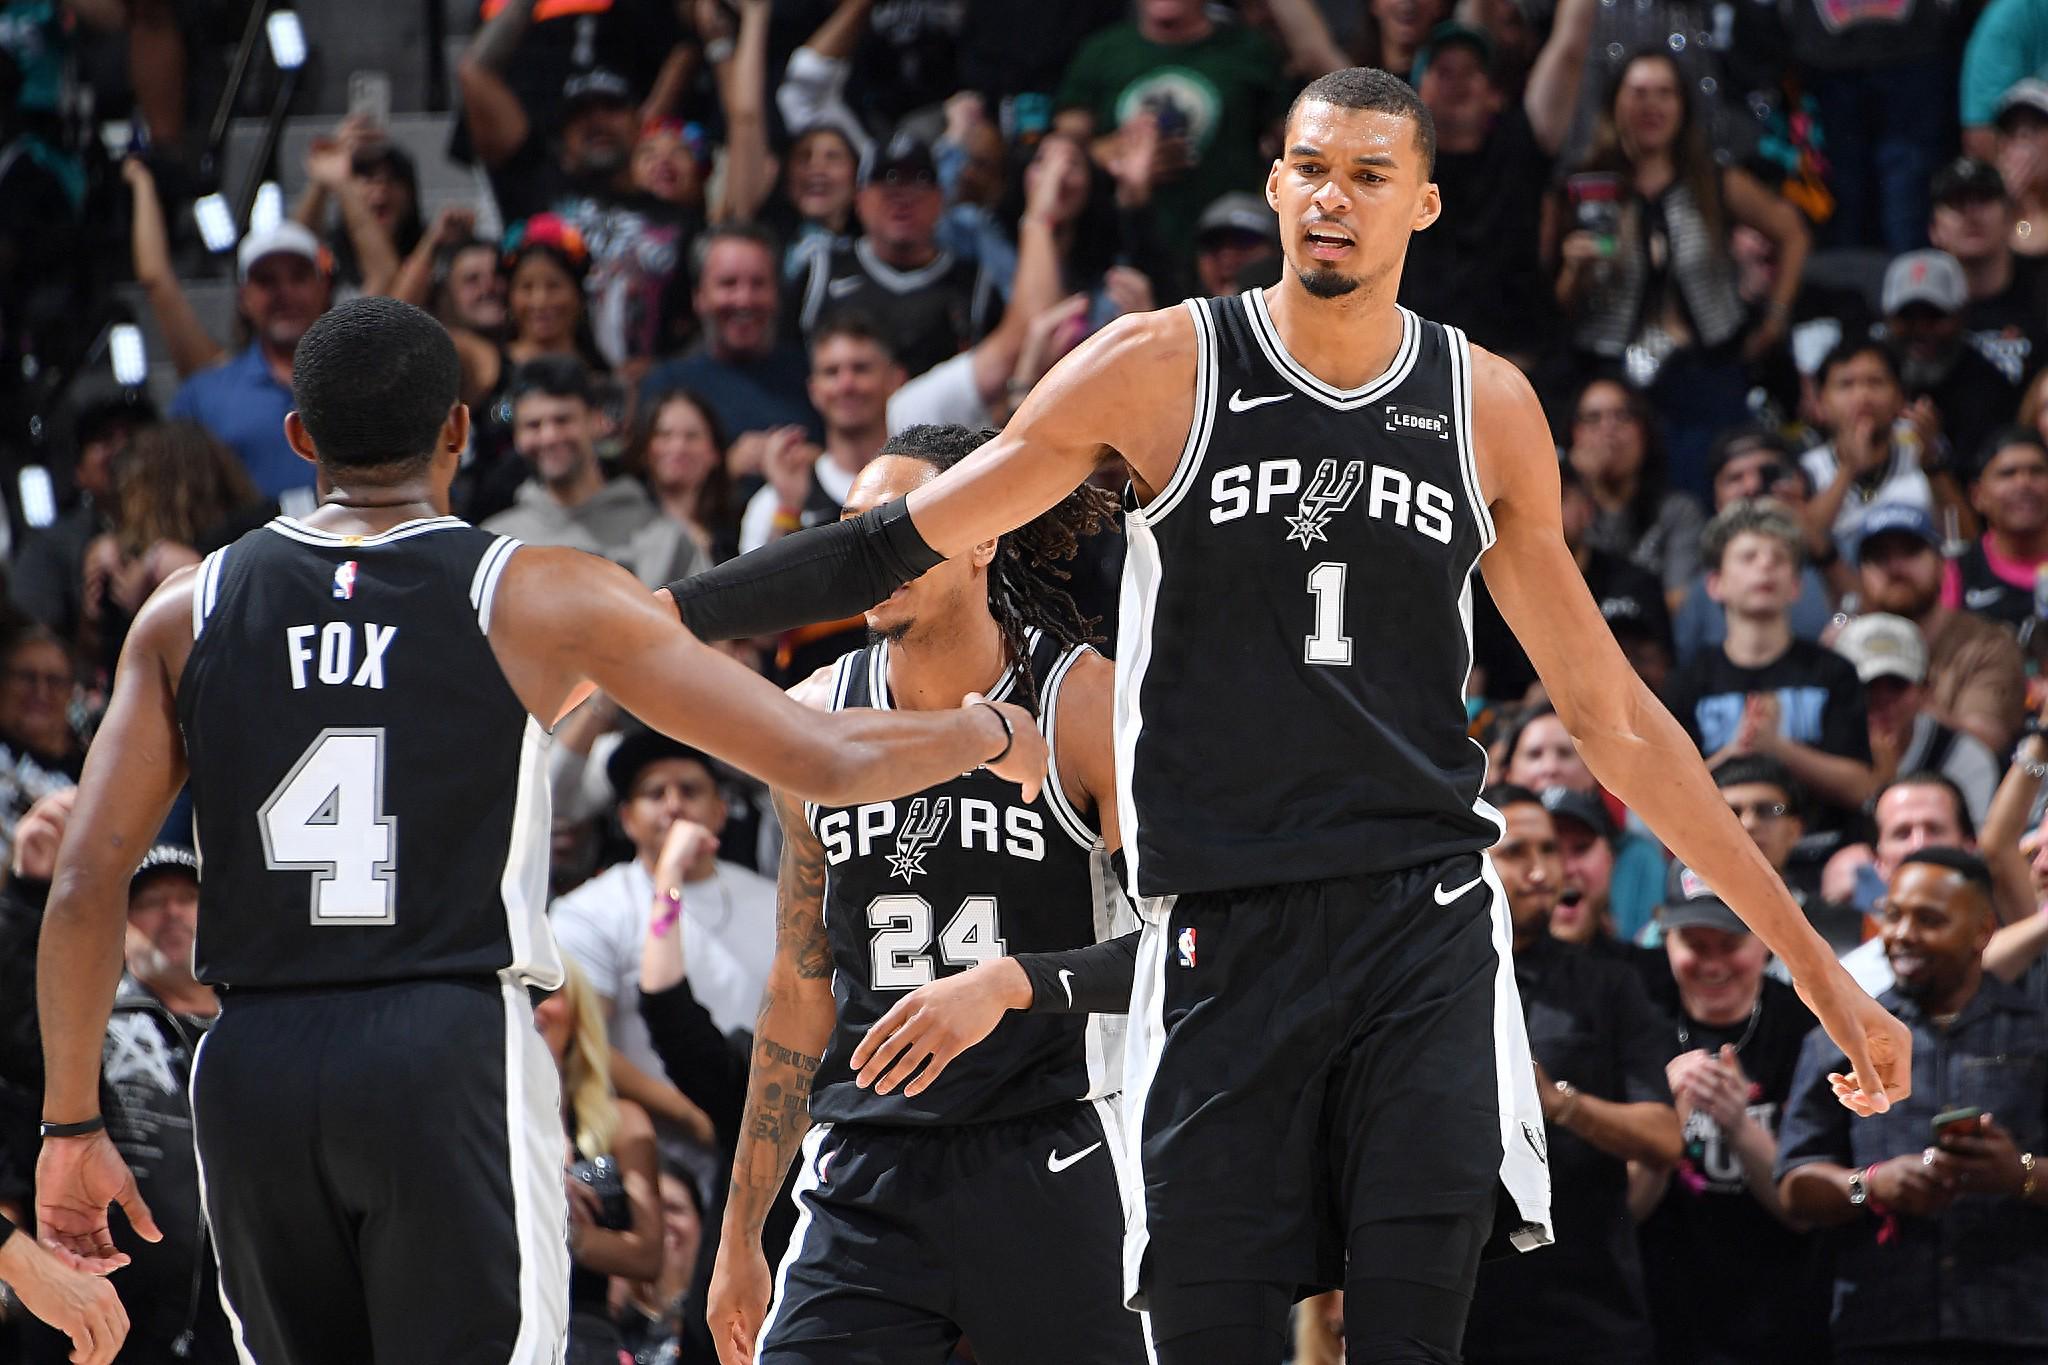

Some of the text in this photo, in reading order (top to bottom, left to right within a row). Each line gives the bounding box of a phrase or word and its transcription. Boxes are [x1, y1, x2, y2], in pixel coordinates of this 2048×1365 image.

[1394, 413, 1442, 432] LEDGER
[1304, 561, 1353, 666] 1
[286, 621, 397, 690] FOX
[256, 727, 398, 926] 4
[866, 894, 1007, 991] 24
[763, 1039, 822, 1072] TRUS
